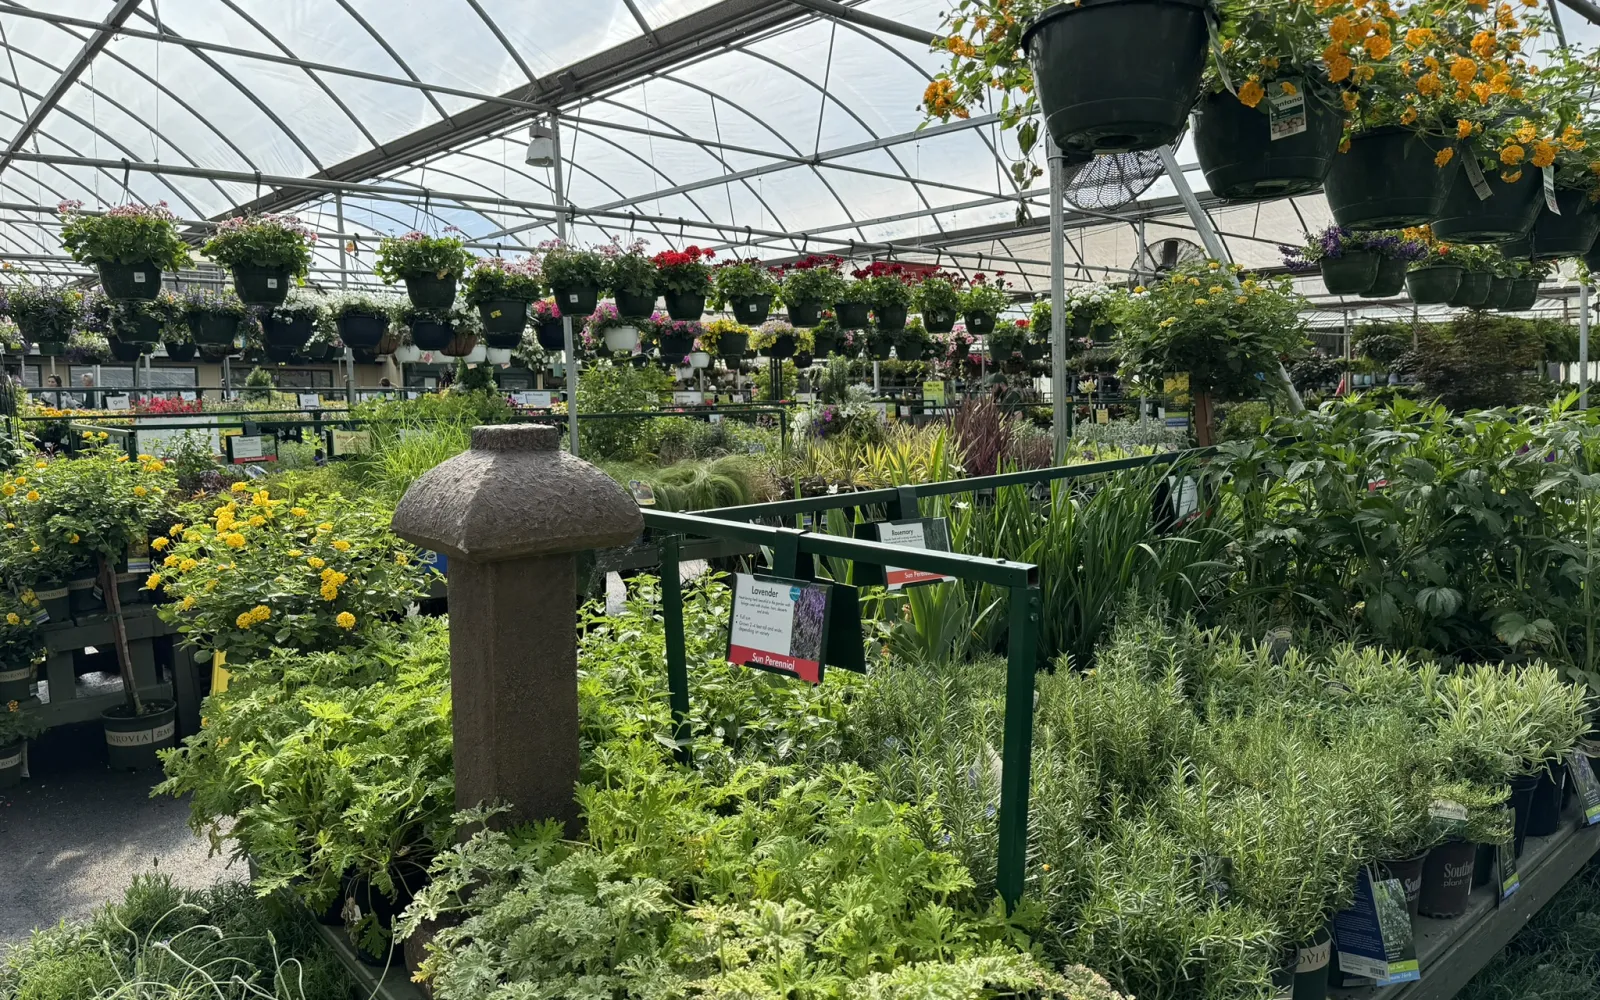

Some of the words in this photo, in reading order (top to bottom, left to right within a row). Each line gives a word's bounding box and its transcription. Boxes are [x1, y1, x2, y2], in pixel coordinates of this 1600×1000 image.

[1275, 96, 1303, 108] antana
[892, 529, 914, 537] Rosemary
[751, 585, 779, 598] Lavender
[752, 652, 764, 664] Sun
[765, 655, 795, 671] Perennial
